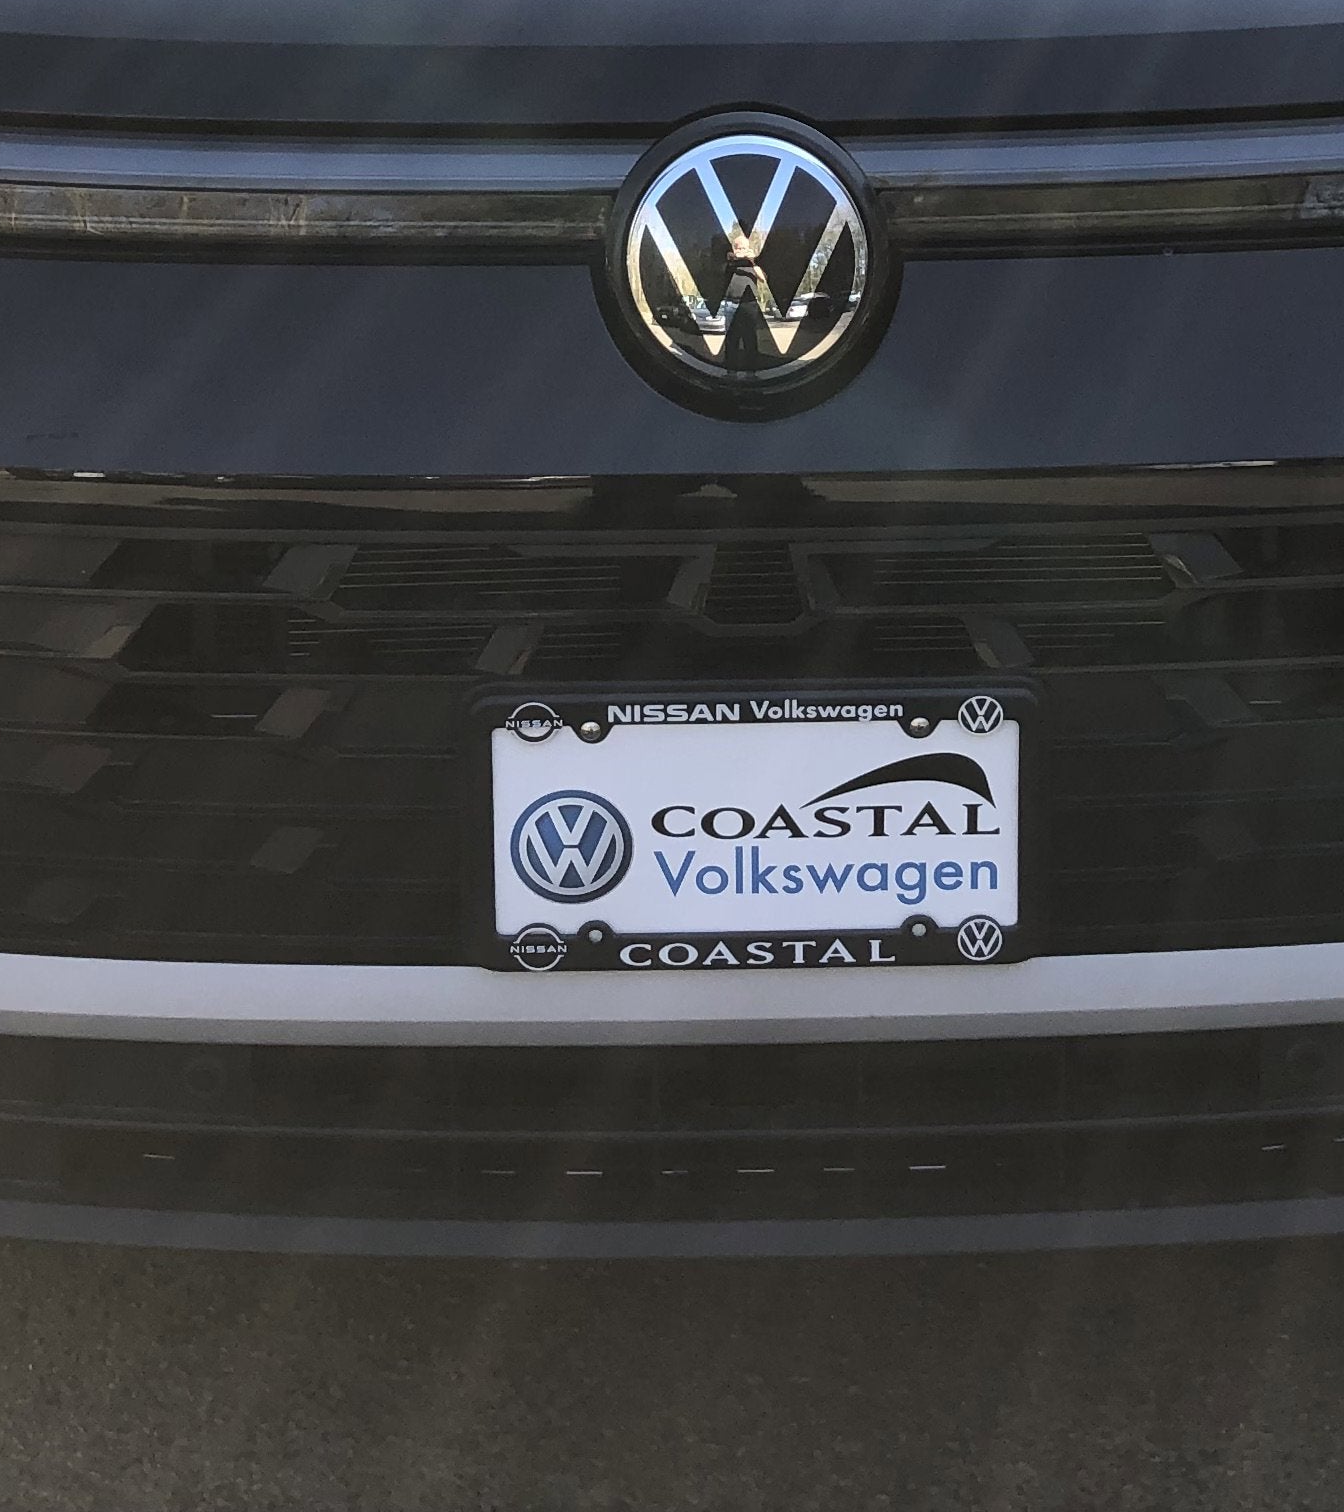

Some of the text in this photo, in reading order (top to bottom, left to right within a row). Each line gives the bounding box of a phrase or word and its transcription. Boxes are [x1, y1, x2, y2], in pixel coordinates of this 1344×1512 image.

[505, 718, 564, 729] NISSAN
[607, 698, 904, 723] NISSAN Volkswagen
[651, 803, 1000, 840] COASTAL
[653, 845, 999, 905] Volkswagen
[509, 944, 568, 954] NISSAN
[619, 939, 896, 967] COASTAL
